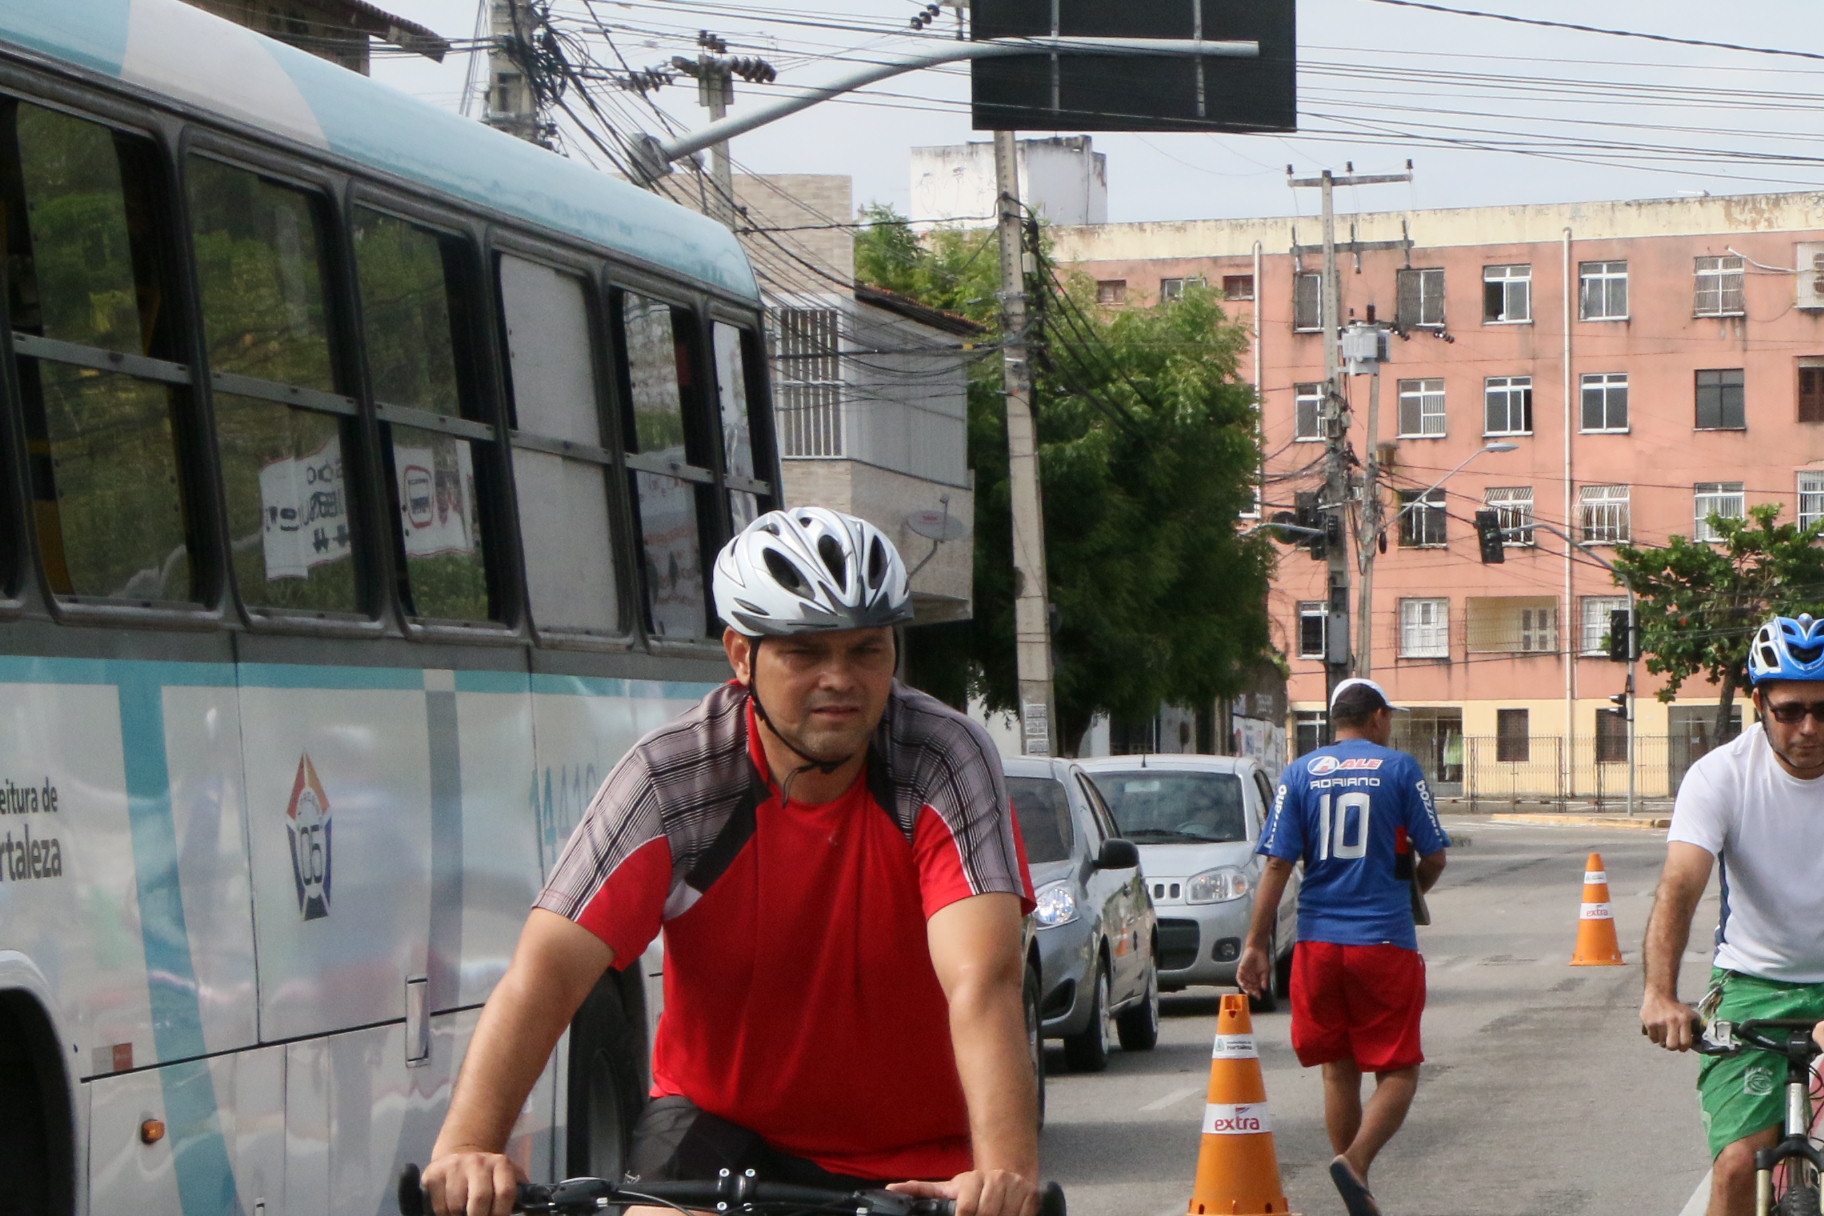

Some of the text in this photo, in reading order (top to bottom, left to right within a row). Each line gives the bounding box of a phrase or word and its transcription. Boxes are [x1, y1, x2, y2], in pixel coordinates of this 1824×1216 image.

[1339, 758, 1384, 771] ALE
[1310, 776, 1381, 790] ADRIANO
[42, 775, 58, 812] de
[1318, 791, 1371, 861] 10
[1586, 908, 1609, 917] extra
[1214, 1116, 1261, 1132] extra
